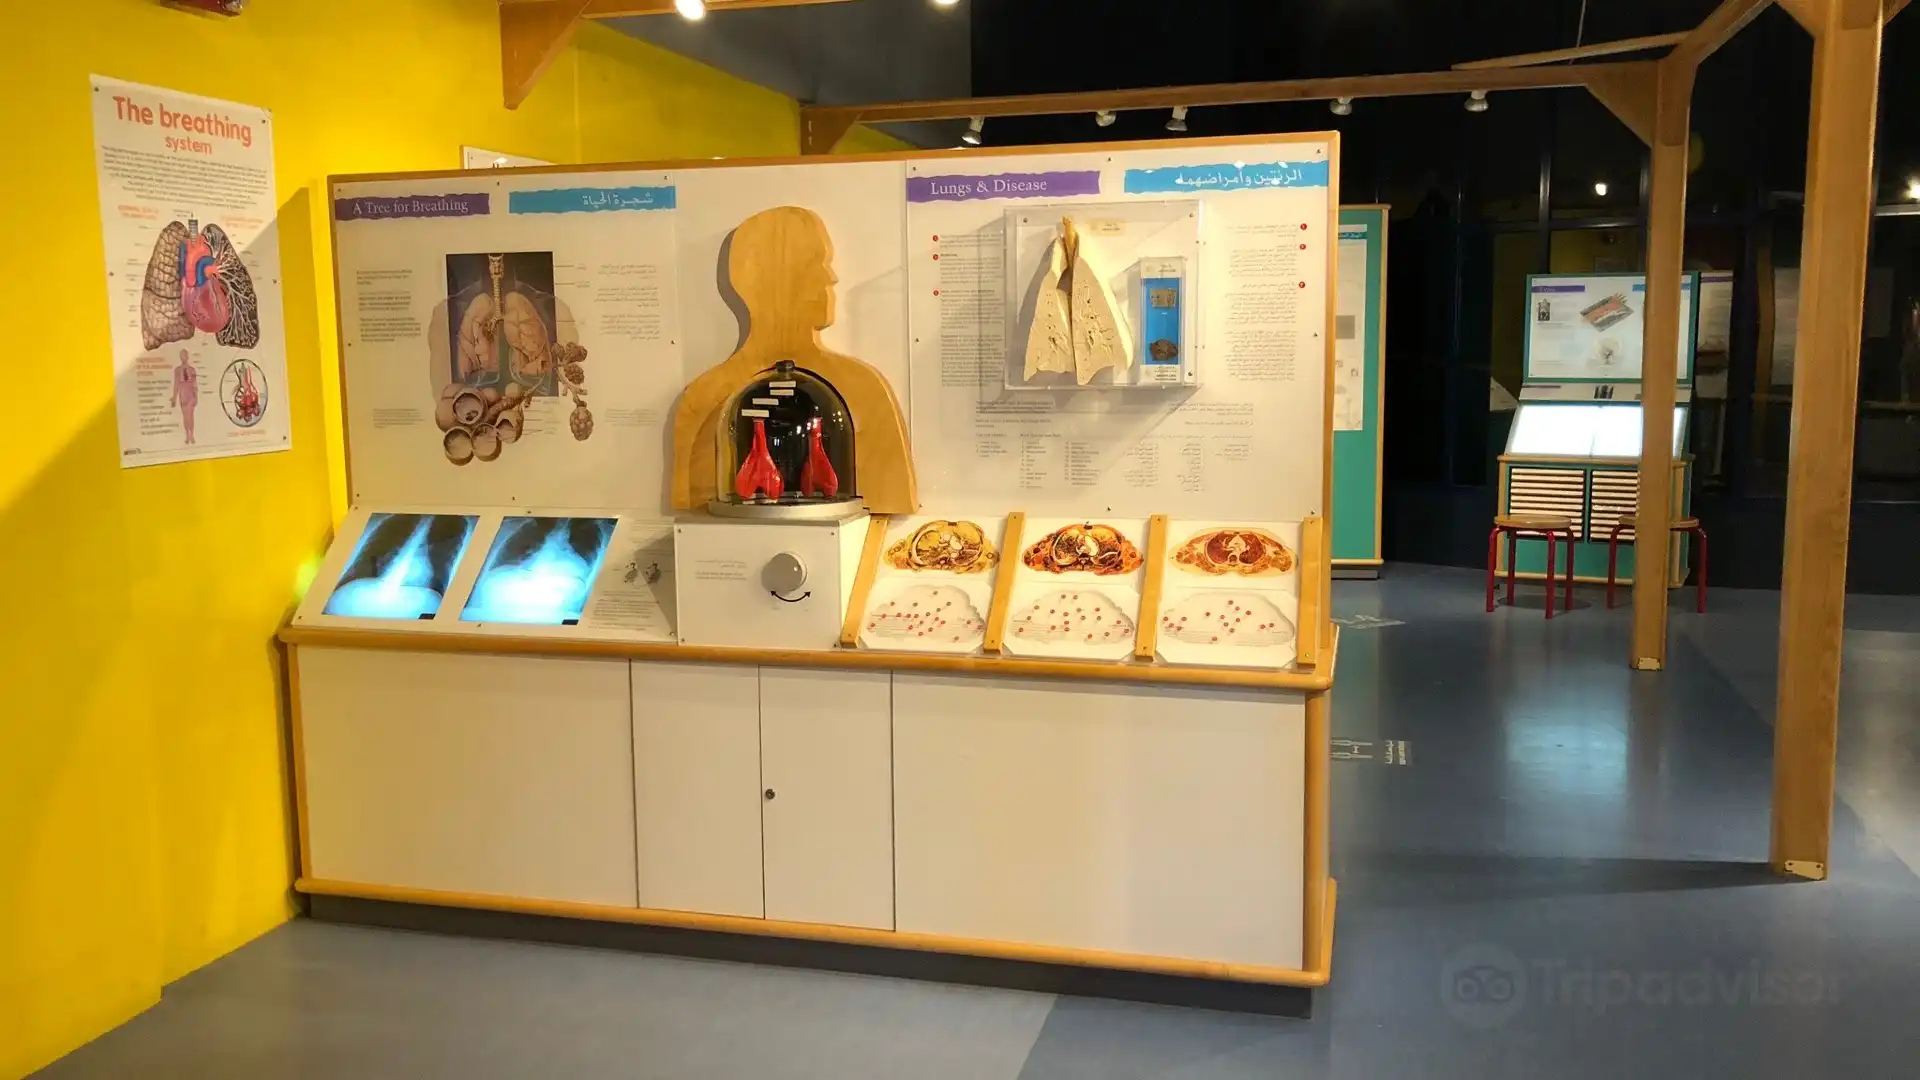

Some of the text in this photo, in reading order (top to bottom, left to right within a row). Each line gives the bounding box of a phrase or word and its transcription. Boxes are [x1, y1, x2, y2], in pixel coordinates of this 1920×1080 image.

[113, 96, 253, 148] The breathing
[165, 135, 212, 155] system
[930, 179, 1047, 197] Lungs & Disease
[353, 198, 469, 214] A Tree for Breathing
[582, 191, 653, 209] شجرة الحياة
